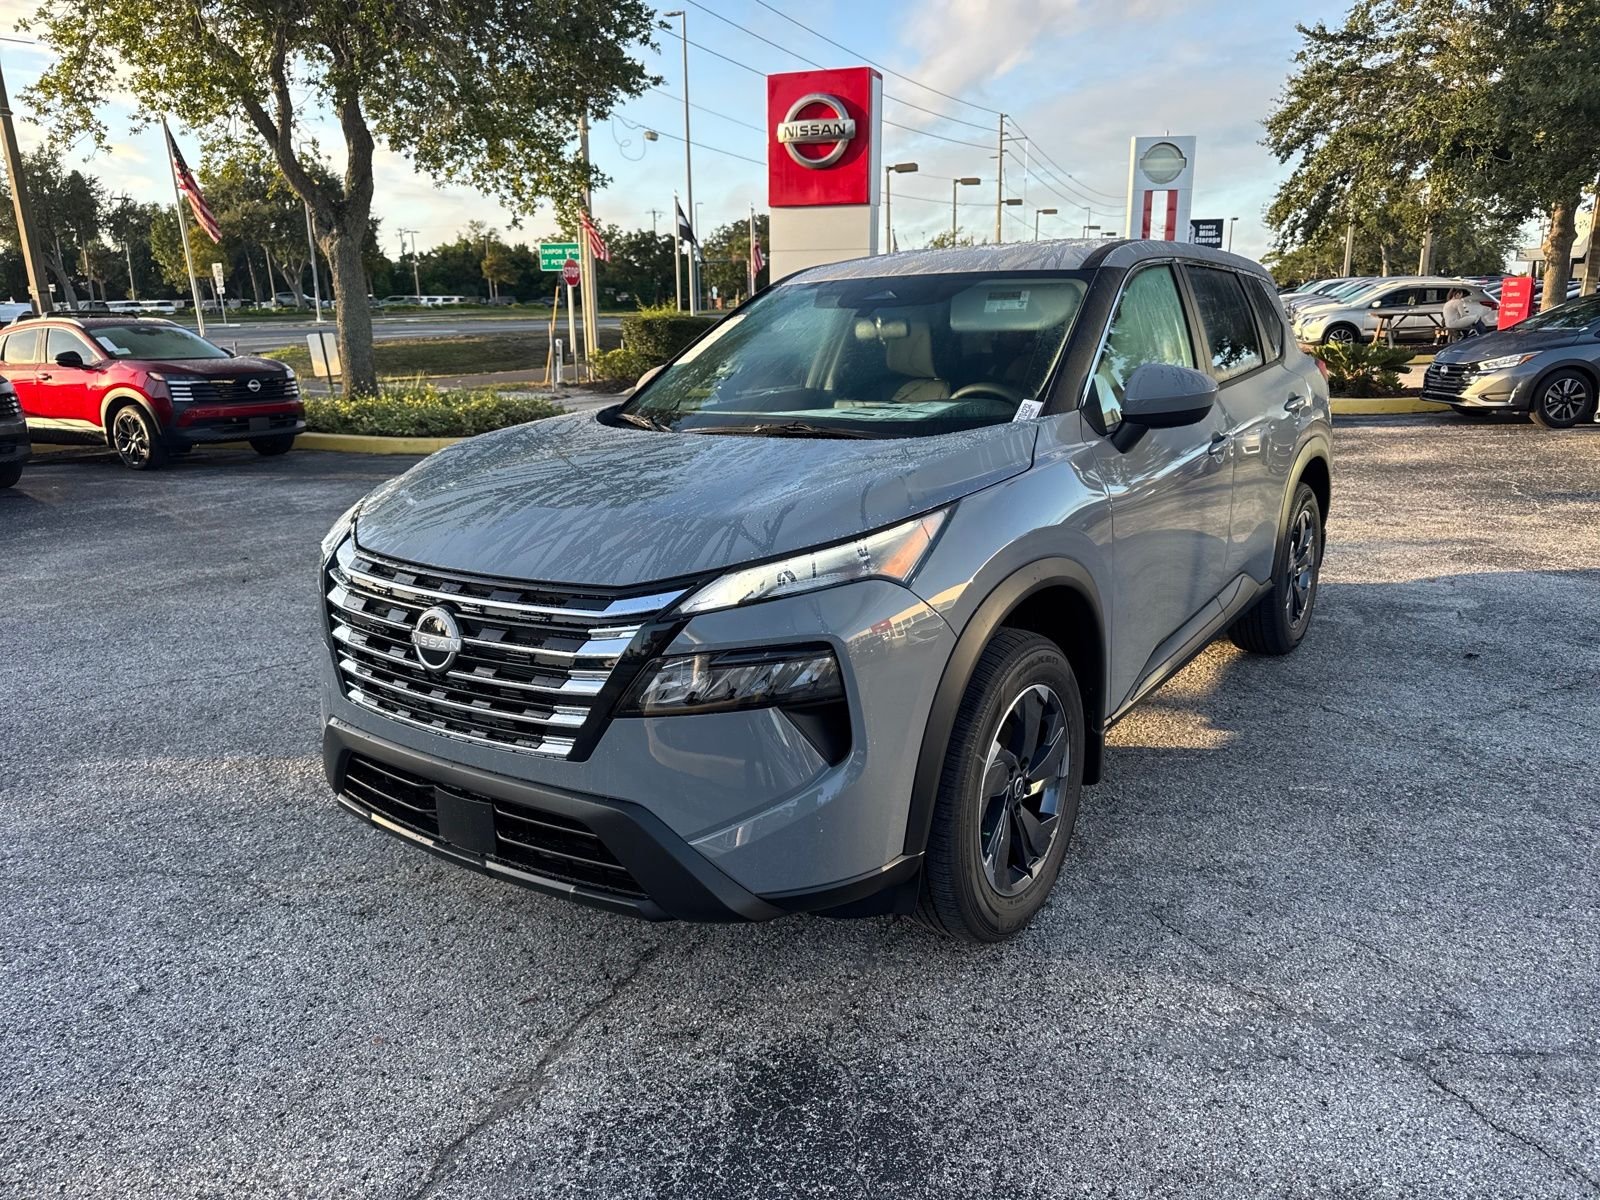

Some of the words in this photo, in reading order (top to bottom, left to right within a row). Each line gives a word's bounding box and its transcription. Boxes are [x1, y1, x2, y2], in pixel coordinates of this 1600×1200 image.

[784, 123, 846, 138] NISSAN
[564, 267, 579, 278] STOP
[412, 633, 459, 651] NISSAN
